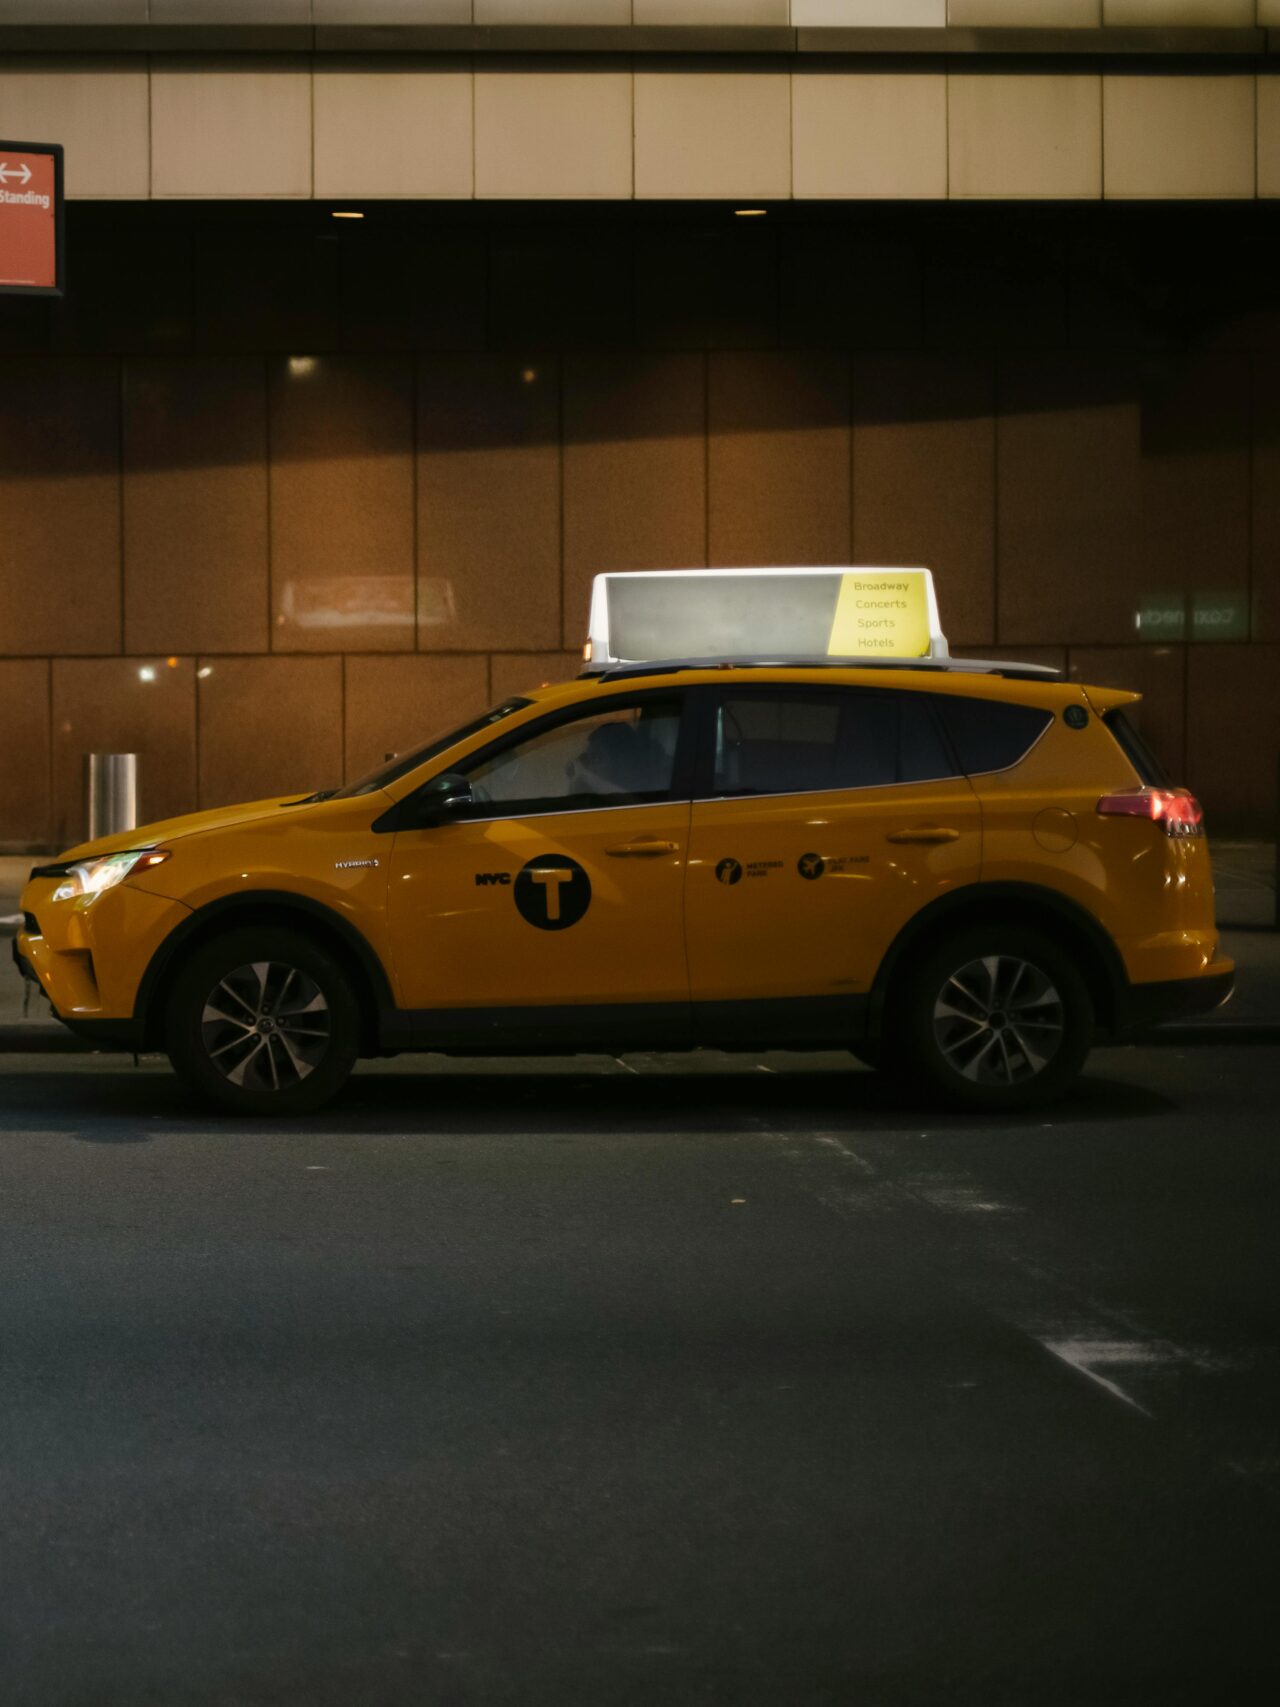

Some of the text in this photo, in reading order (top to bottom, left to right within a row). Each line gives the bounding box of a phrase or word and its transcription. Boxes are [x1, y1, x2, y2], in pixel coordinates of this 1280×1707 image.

[854, 582, 910, 592] Broadway
[855, 599, 907, 609] Concerts
[857, 618, 895, 629] Sports
[858, 638, 895, 648] Hotels
[475, 868, 573, 921] NYC T
